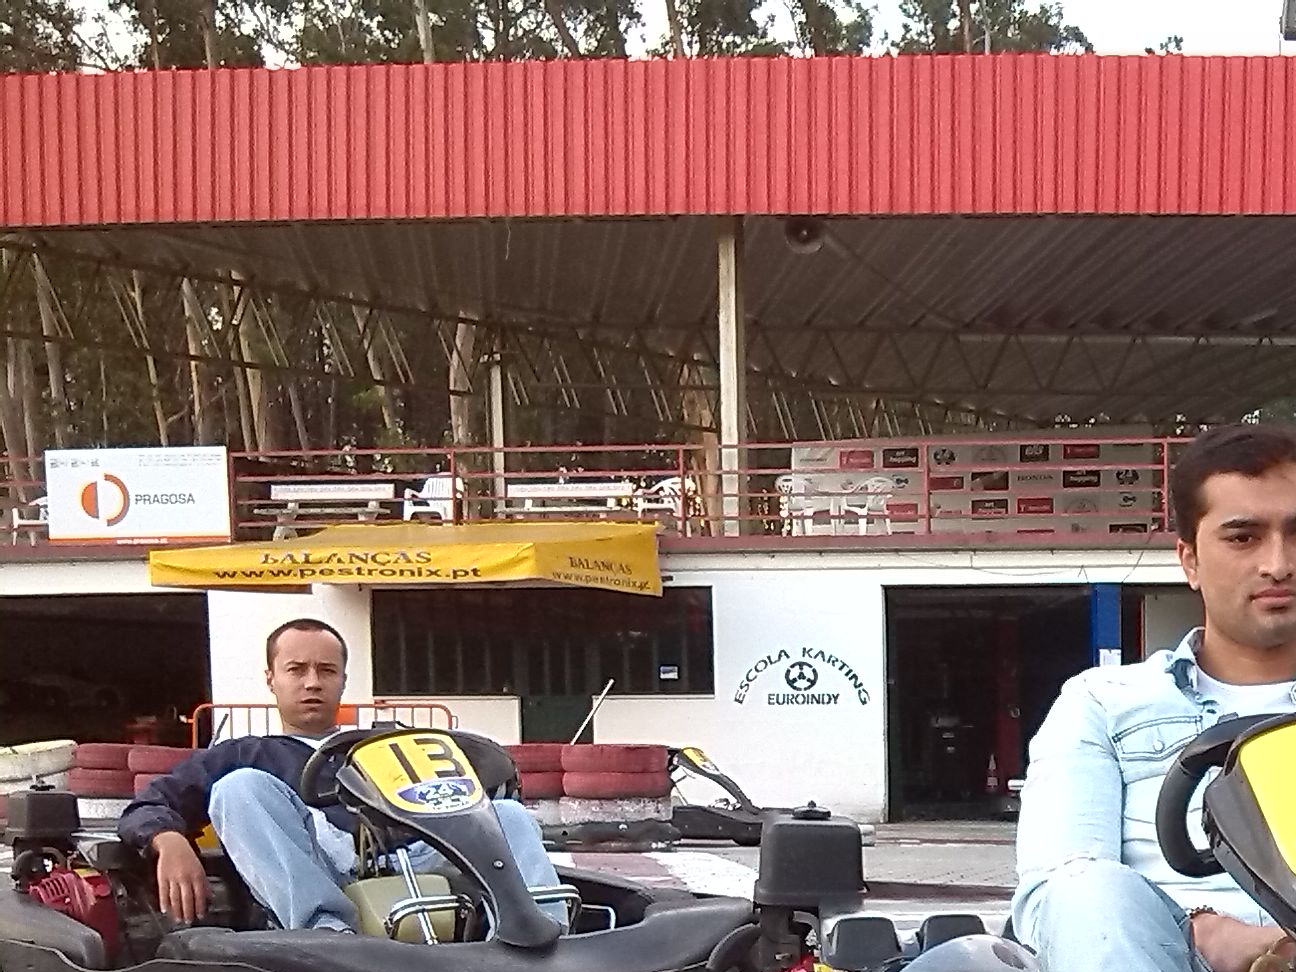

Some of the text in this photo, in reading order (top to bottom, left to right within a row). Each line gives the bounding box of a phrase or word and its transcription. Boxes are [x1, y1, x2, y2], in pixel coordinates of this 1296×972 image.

[135, 493, 195, 504] PRAGOSA
[215, 565, 482, 580] www.pestronix.pt
[734, 647, 871, 706] ESCOLA KARTING
[767, 693, 840, 706] EUROINDY
[388, 737, 467, 785] 13
